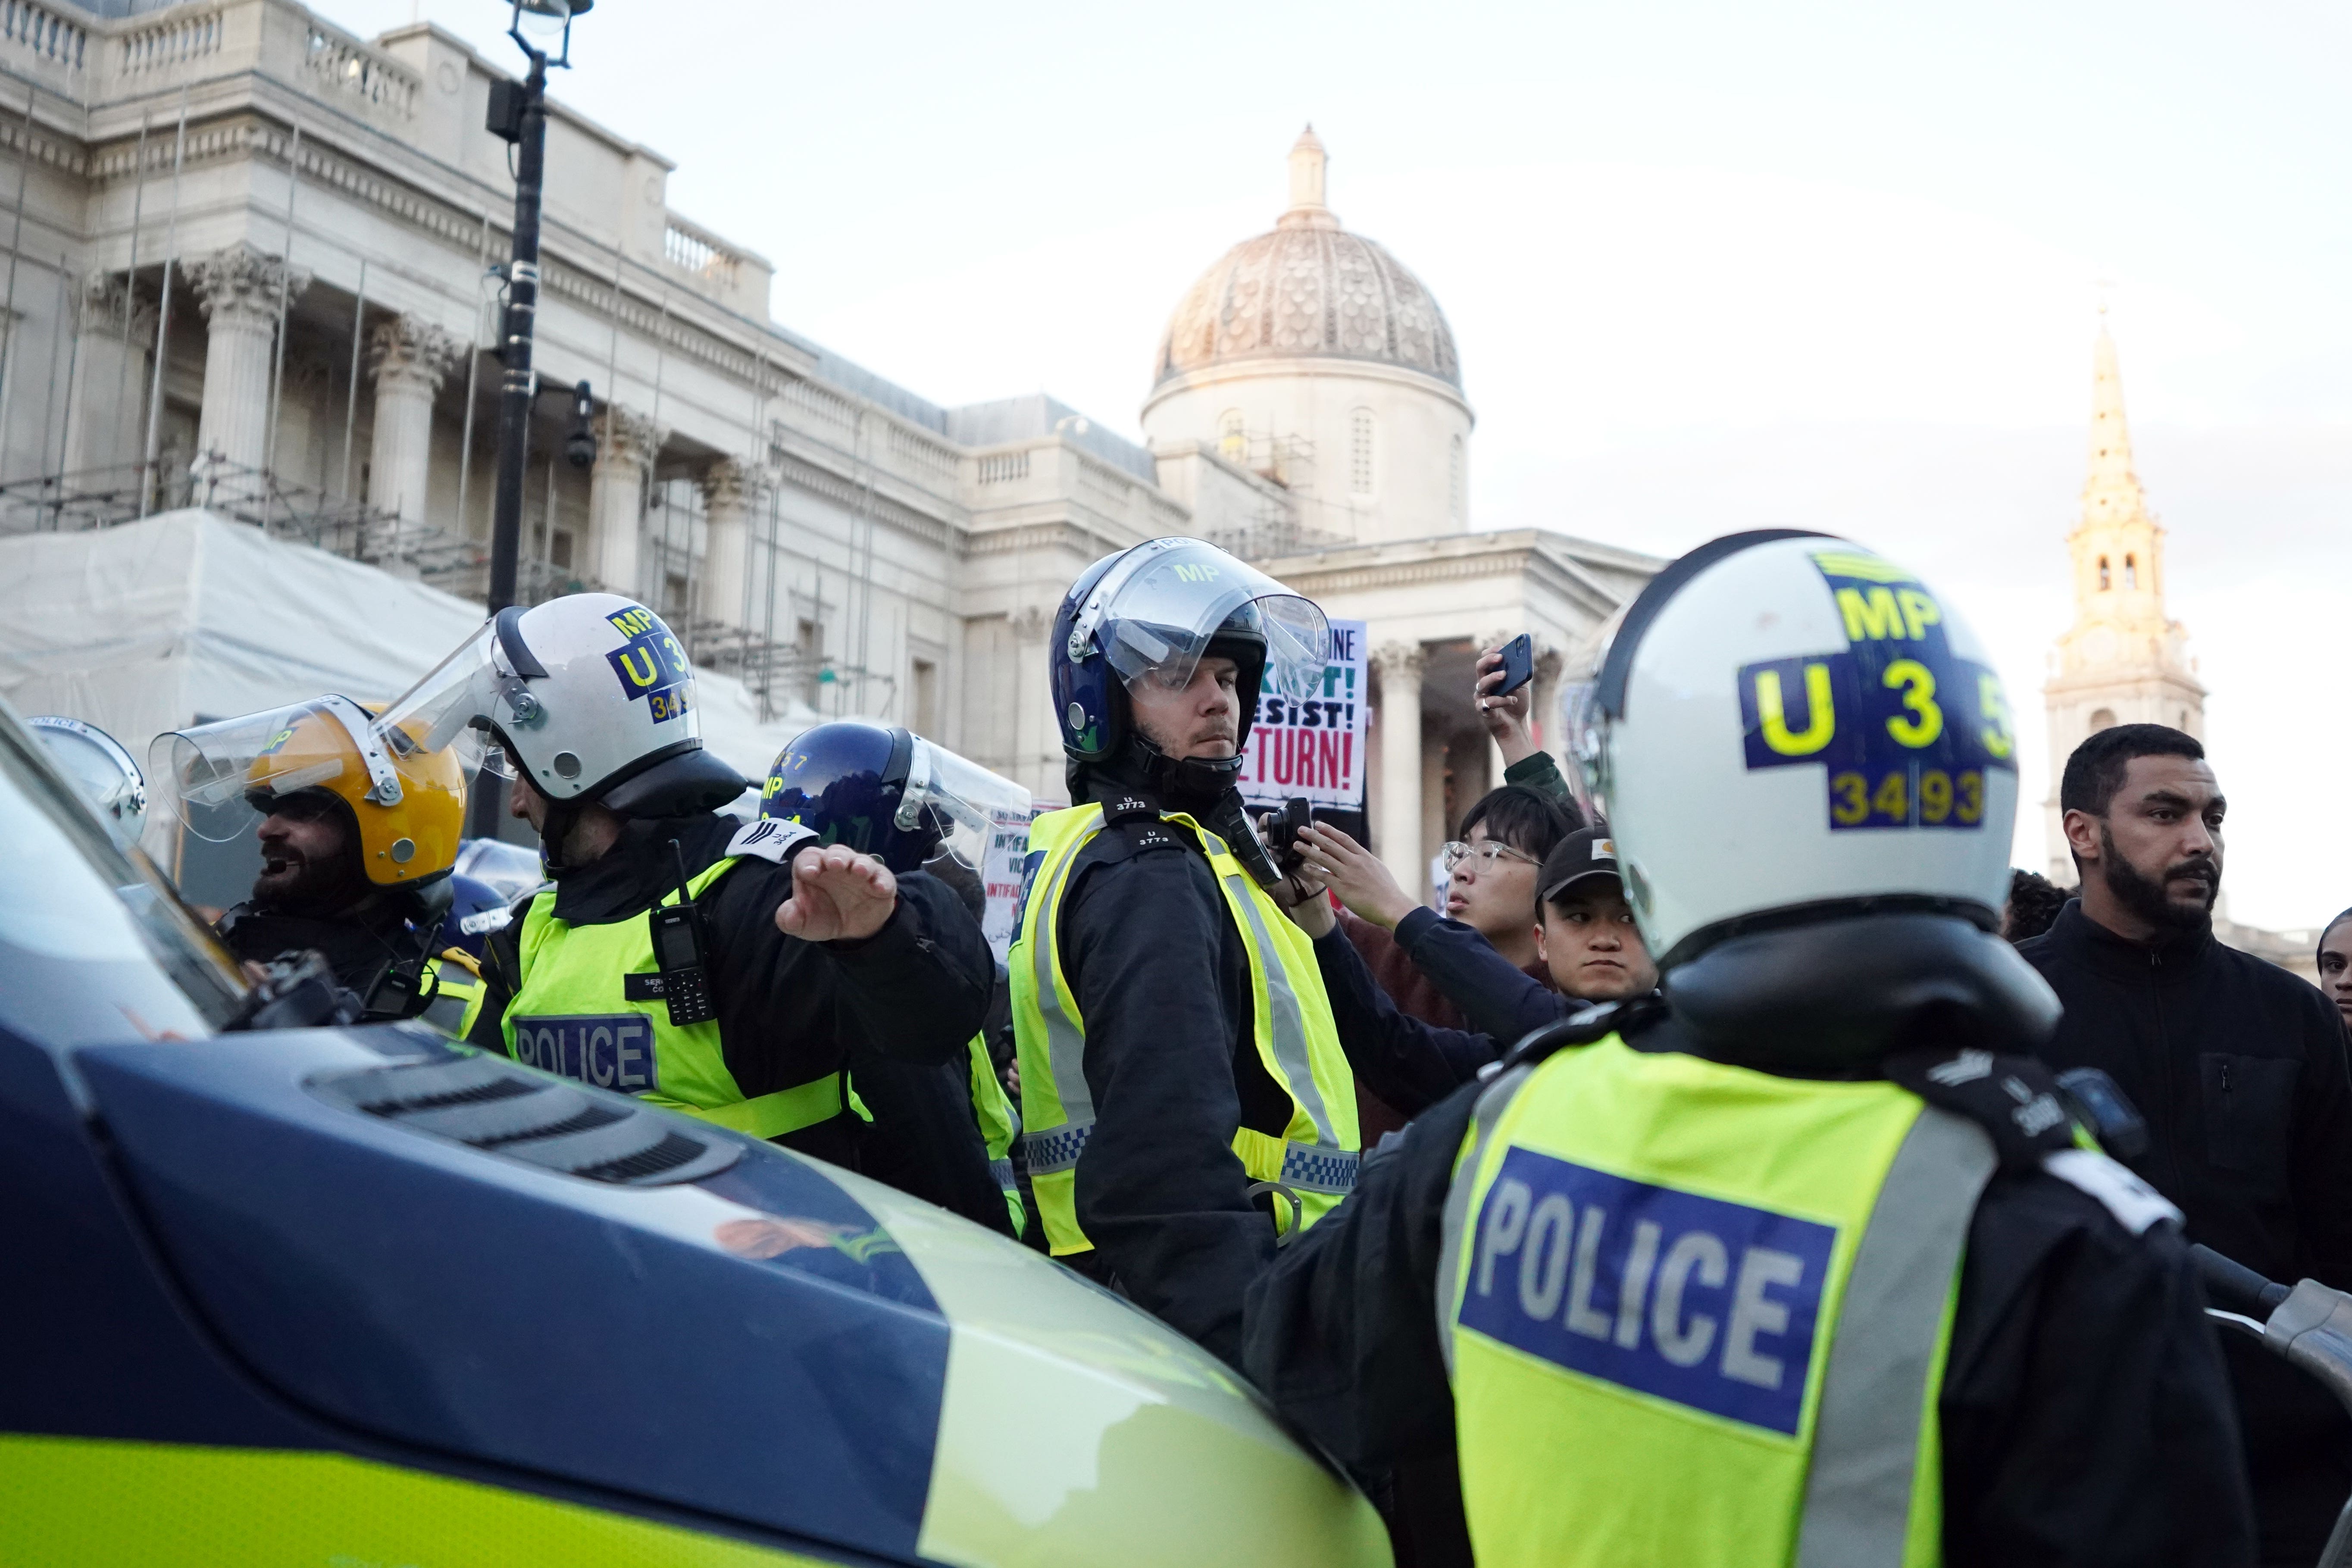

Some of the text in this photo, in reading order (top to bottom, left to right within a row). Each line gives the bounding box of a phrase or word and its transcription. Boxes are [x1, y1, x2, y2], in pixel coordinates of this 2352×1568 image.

[1173, 564, 1220, 582] MP
[611, 609, 652, 638] MP
[1835, 586, 1941, 641] MP
[619, 637, 685, 686] U 3
[1755, 662, 1836, 757] U
[1882, 658, 1944, 749] 3
[761, 776, 783, 799] MP
[1117, 801, 1146, 810] 3773
[1830, 769, 1984, 826] 3493
[773, 832, 797, 845] 3064
[519, 1026, 646, 1088] POLICE
[1477, 1176, 1806, 1392] POLICE
